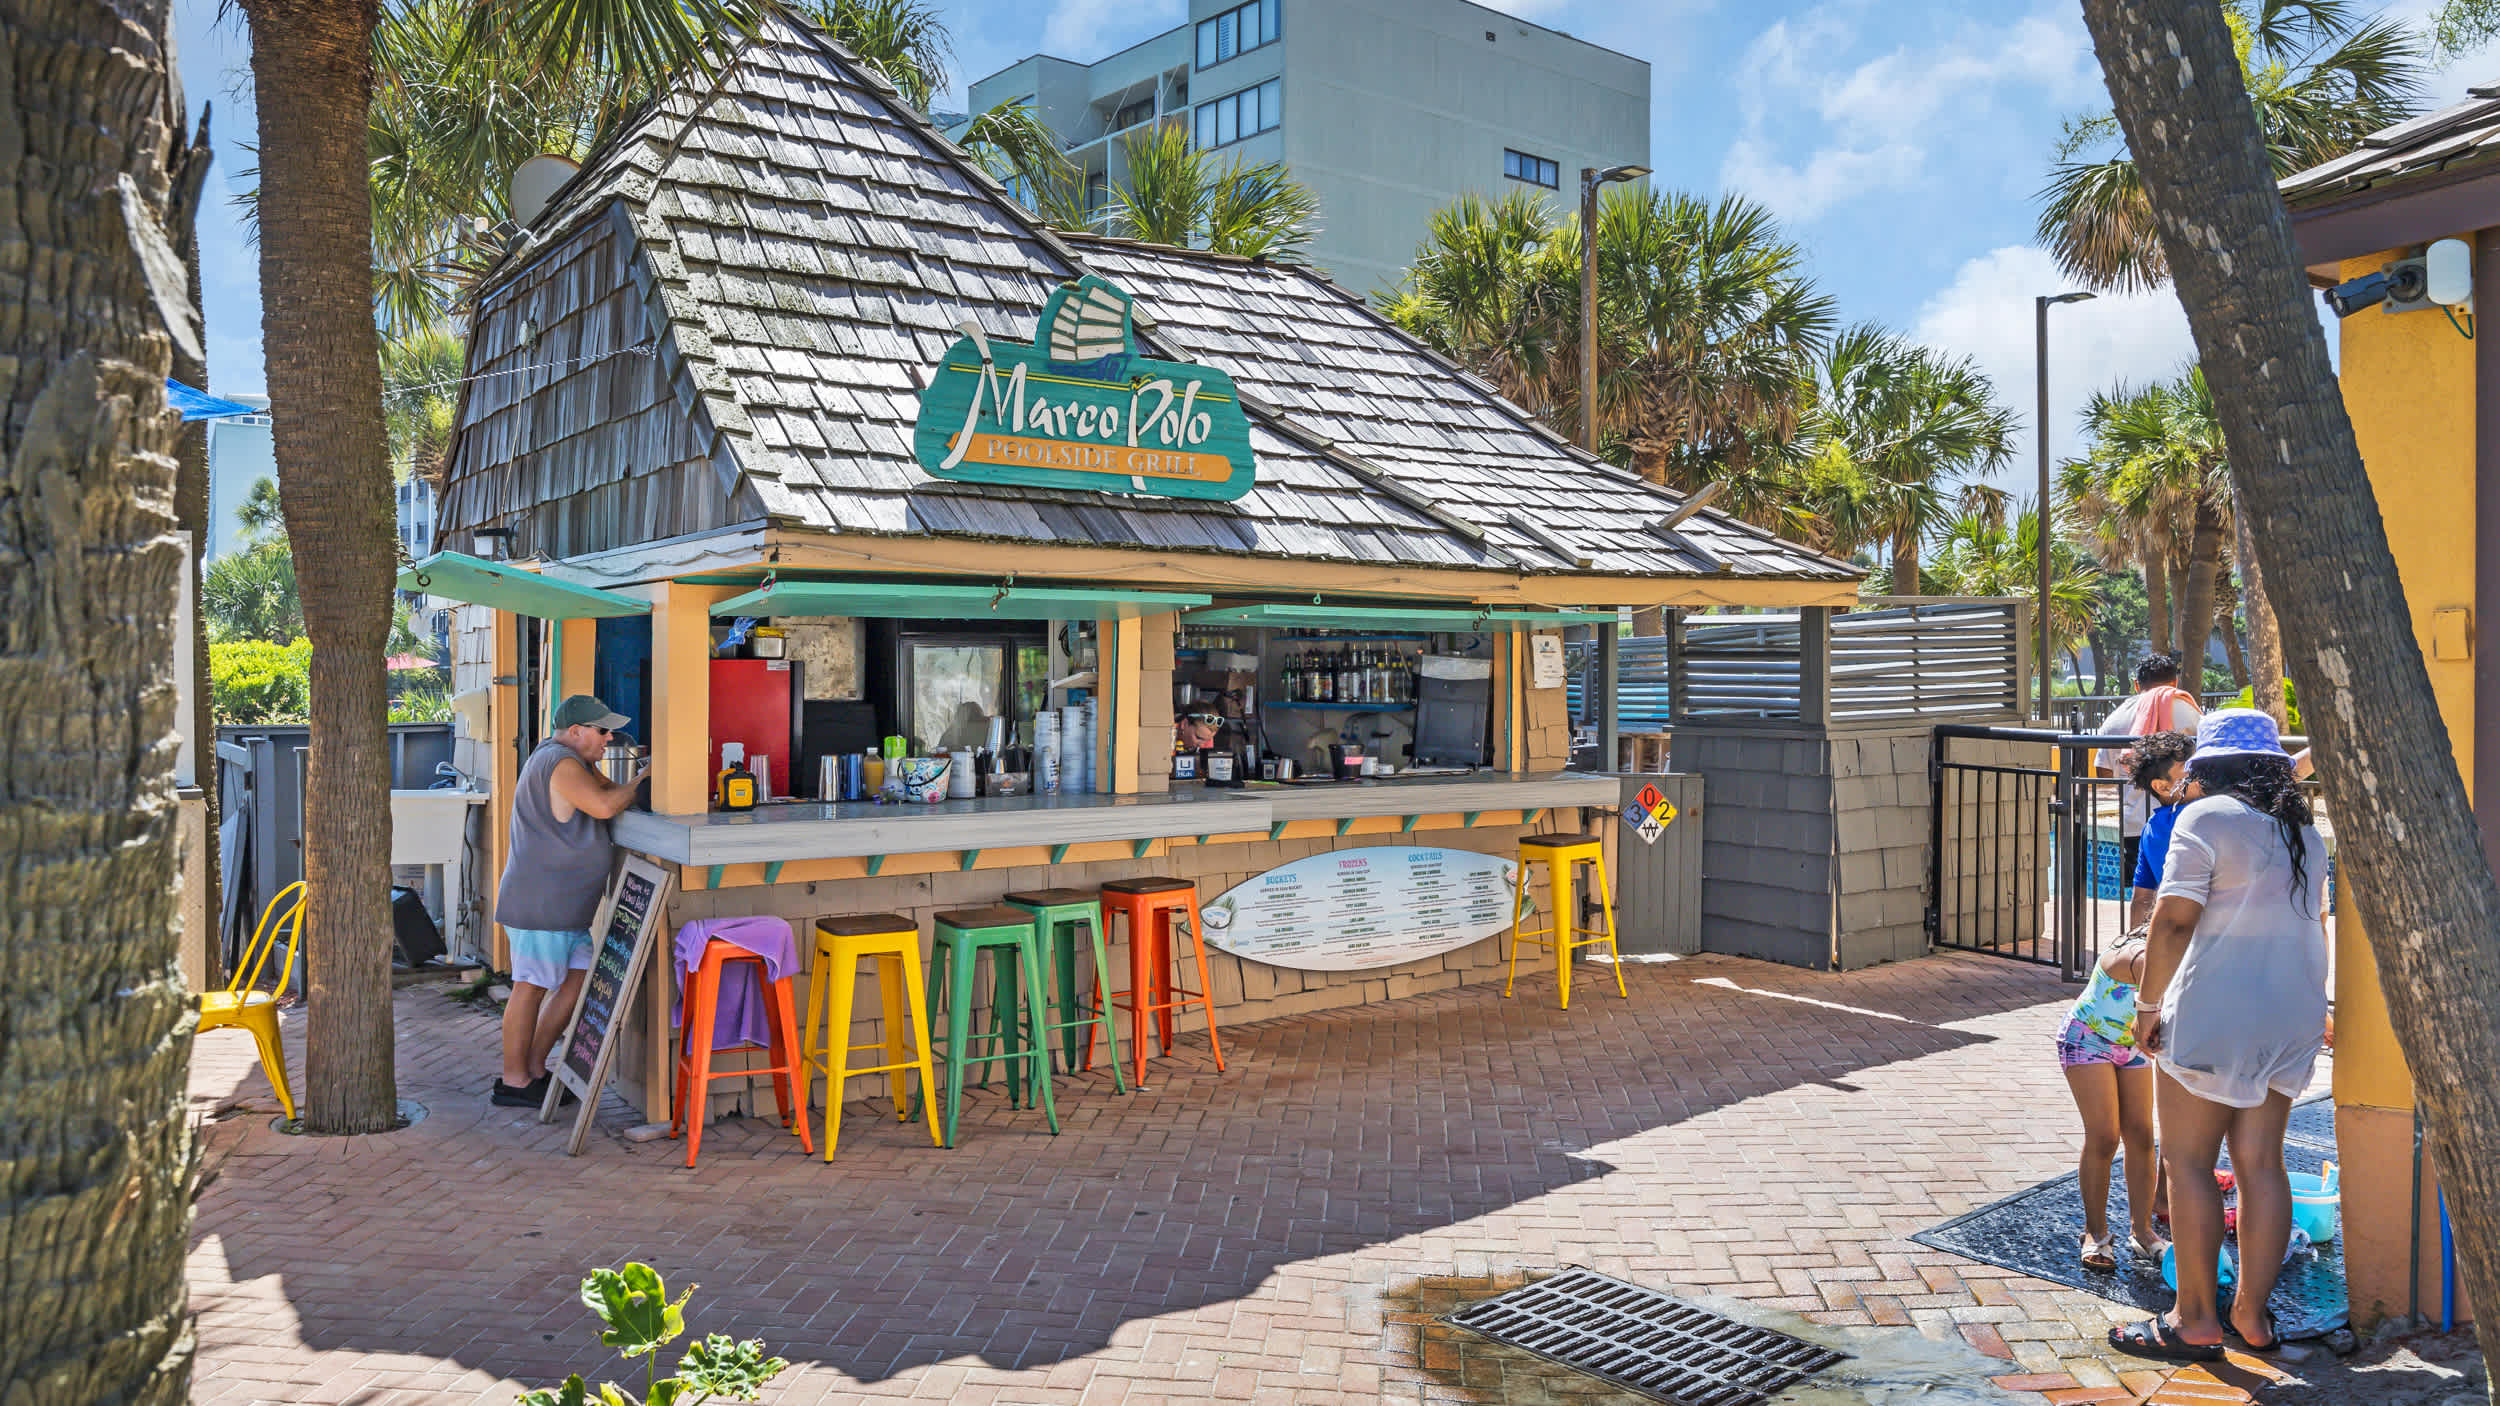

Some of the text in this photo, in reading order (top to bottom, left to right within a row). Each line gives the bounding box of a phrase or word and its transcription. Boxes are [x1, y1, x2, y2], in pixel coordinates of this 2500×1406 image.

[939, 321, 1212, 491] Marco Polo
[987, 439, 1202, 477] POOLSIDE GRILL
[1644, 787, 1655, 807] 0
[1630, 801, 1670, 823] 3 2
[1265, 873, 1297, 885] BUCKETS
